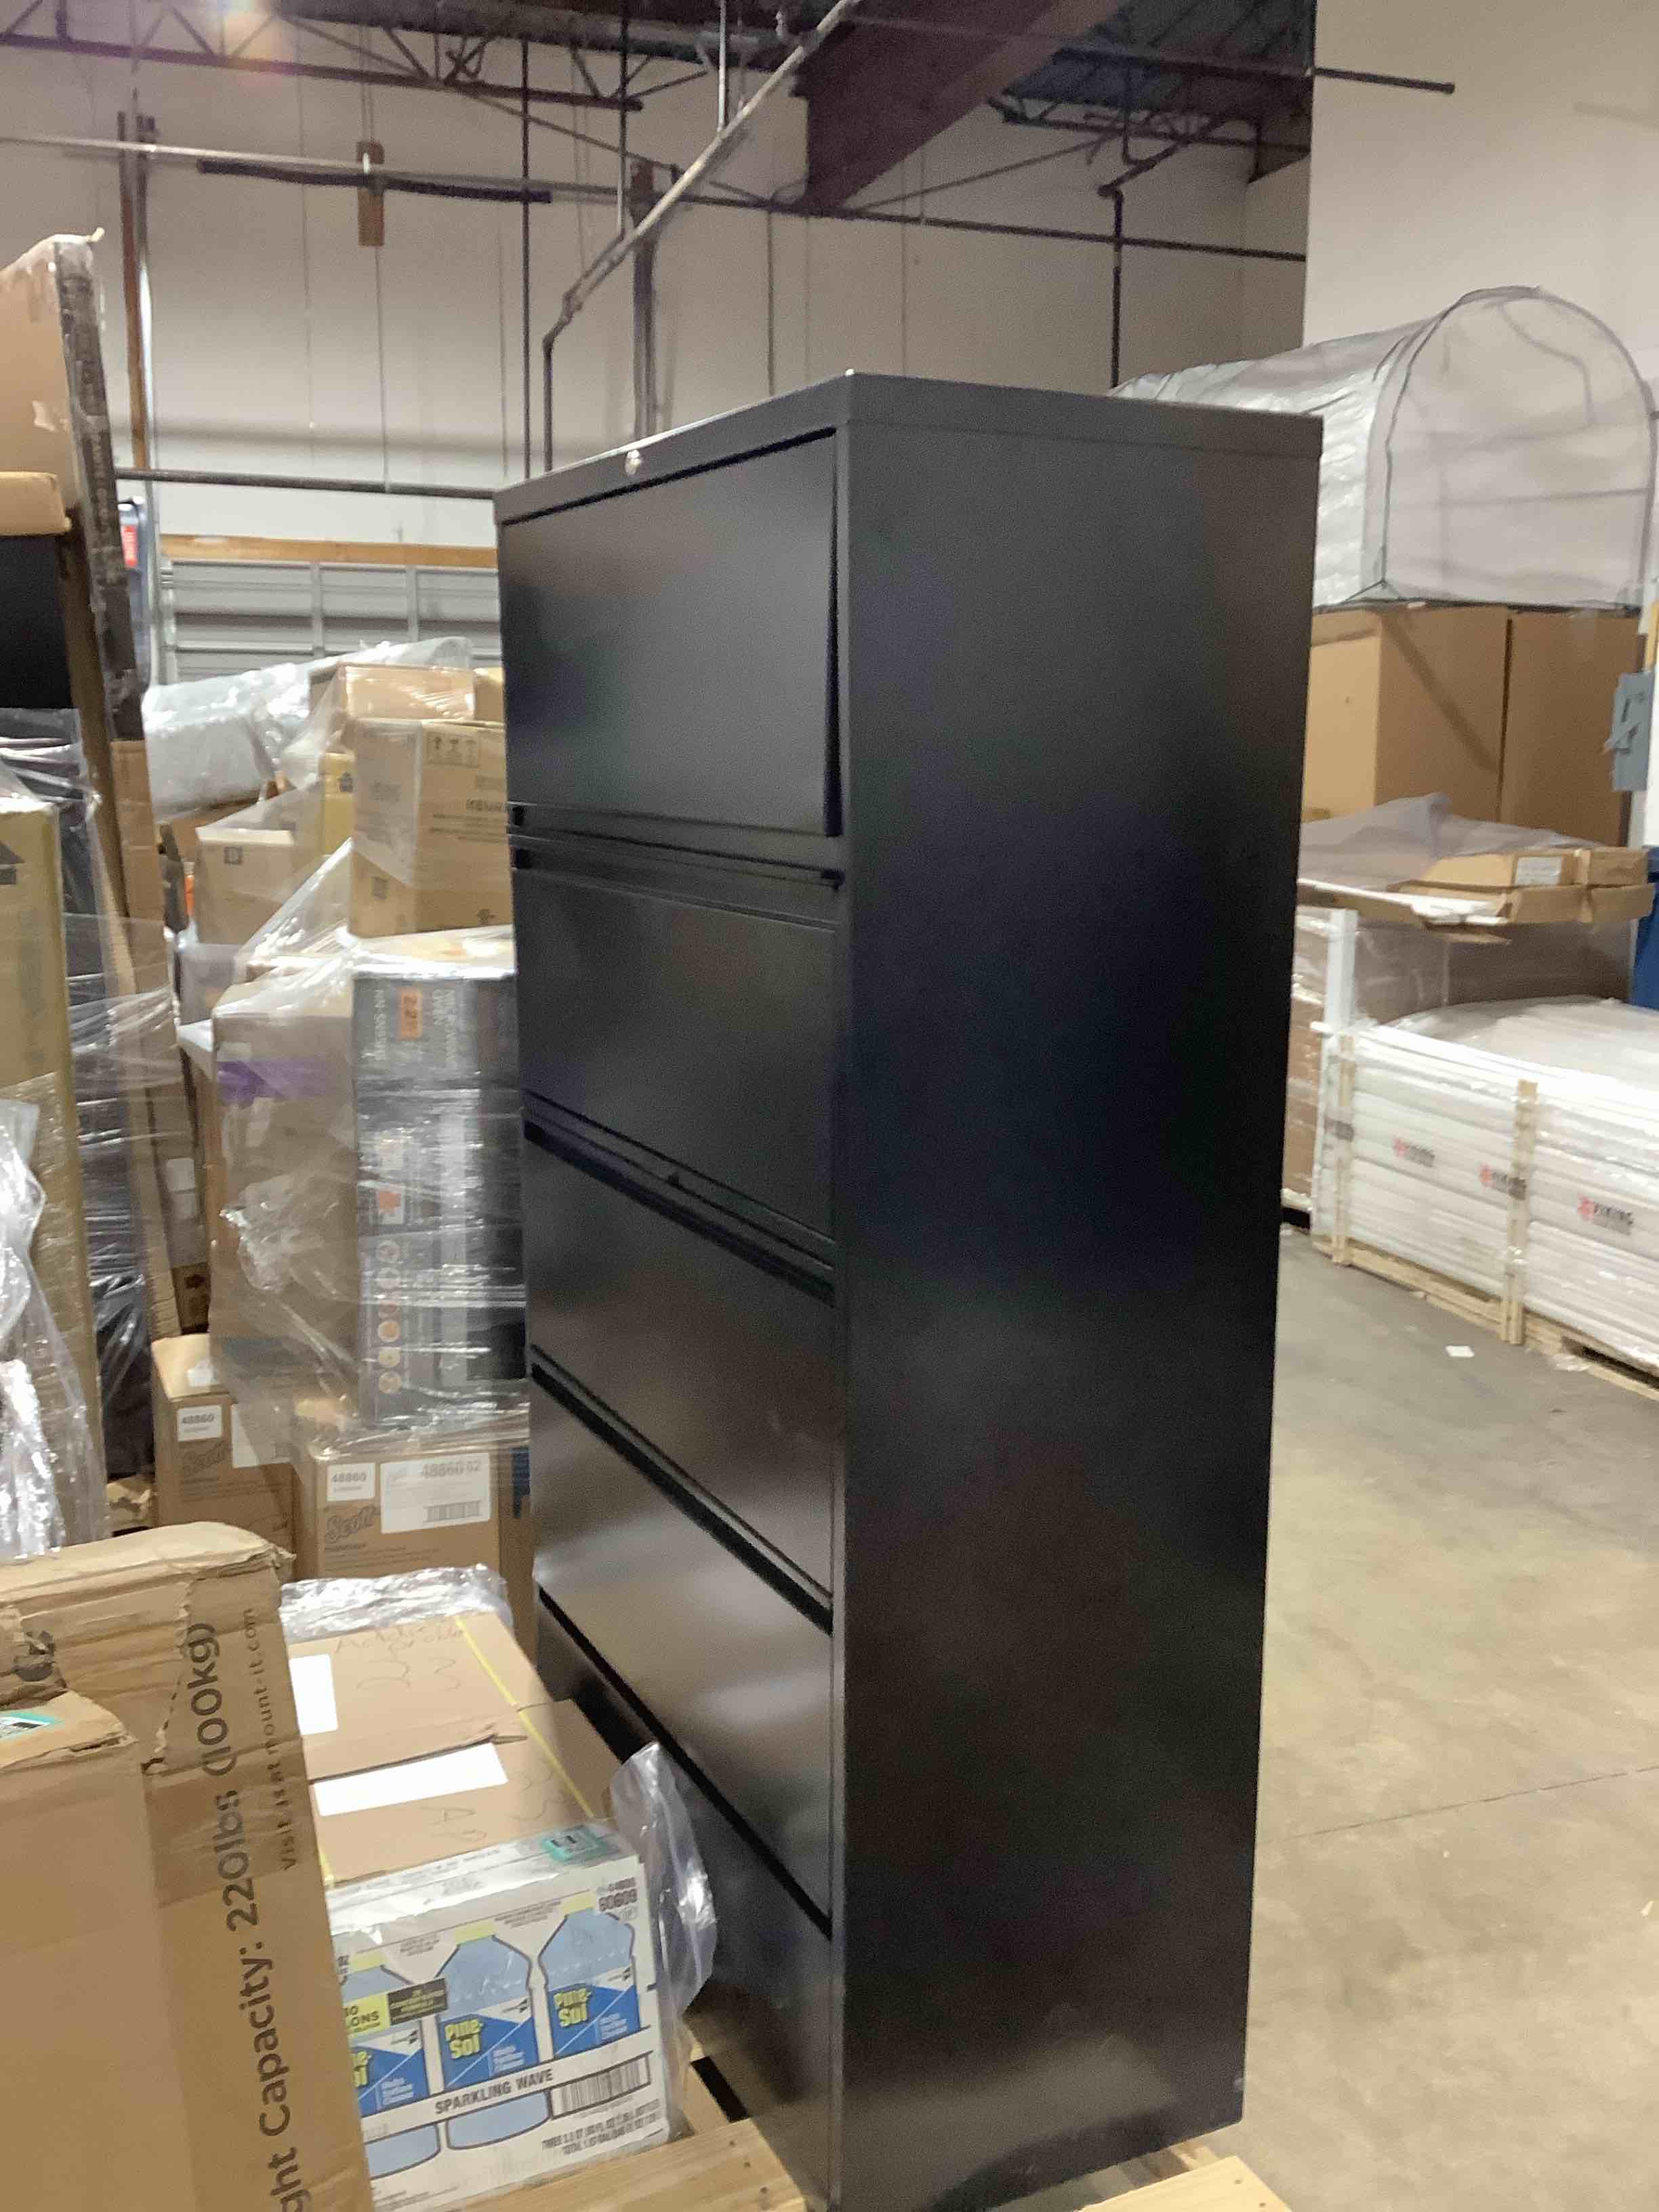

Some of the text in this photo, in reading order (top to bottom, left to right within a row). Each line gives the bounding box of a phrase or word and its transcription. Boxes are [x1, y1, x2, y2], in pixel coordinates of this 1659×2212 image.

[186, 1622, 237, 1777] (100kg)
[211, 1789, 260, 1933] 220lbs
[239, 1941, 291, 2137] Capacity:
[434, 2081, 512, 2115] SPARKLING
[515, 2068, 554, 2091] WAVE
